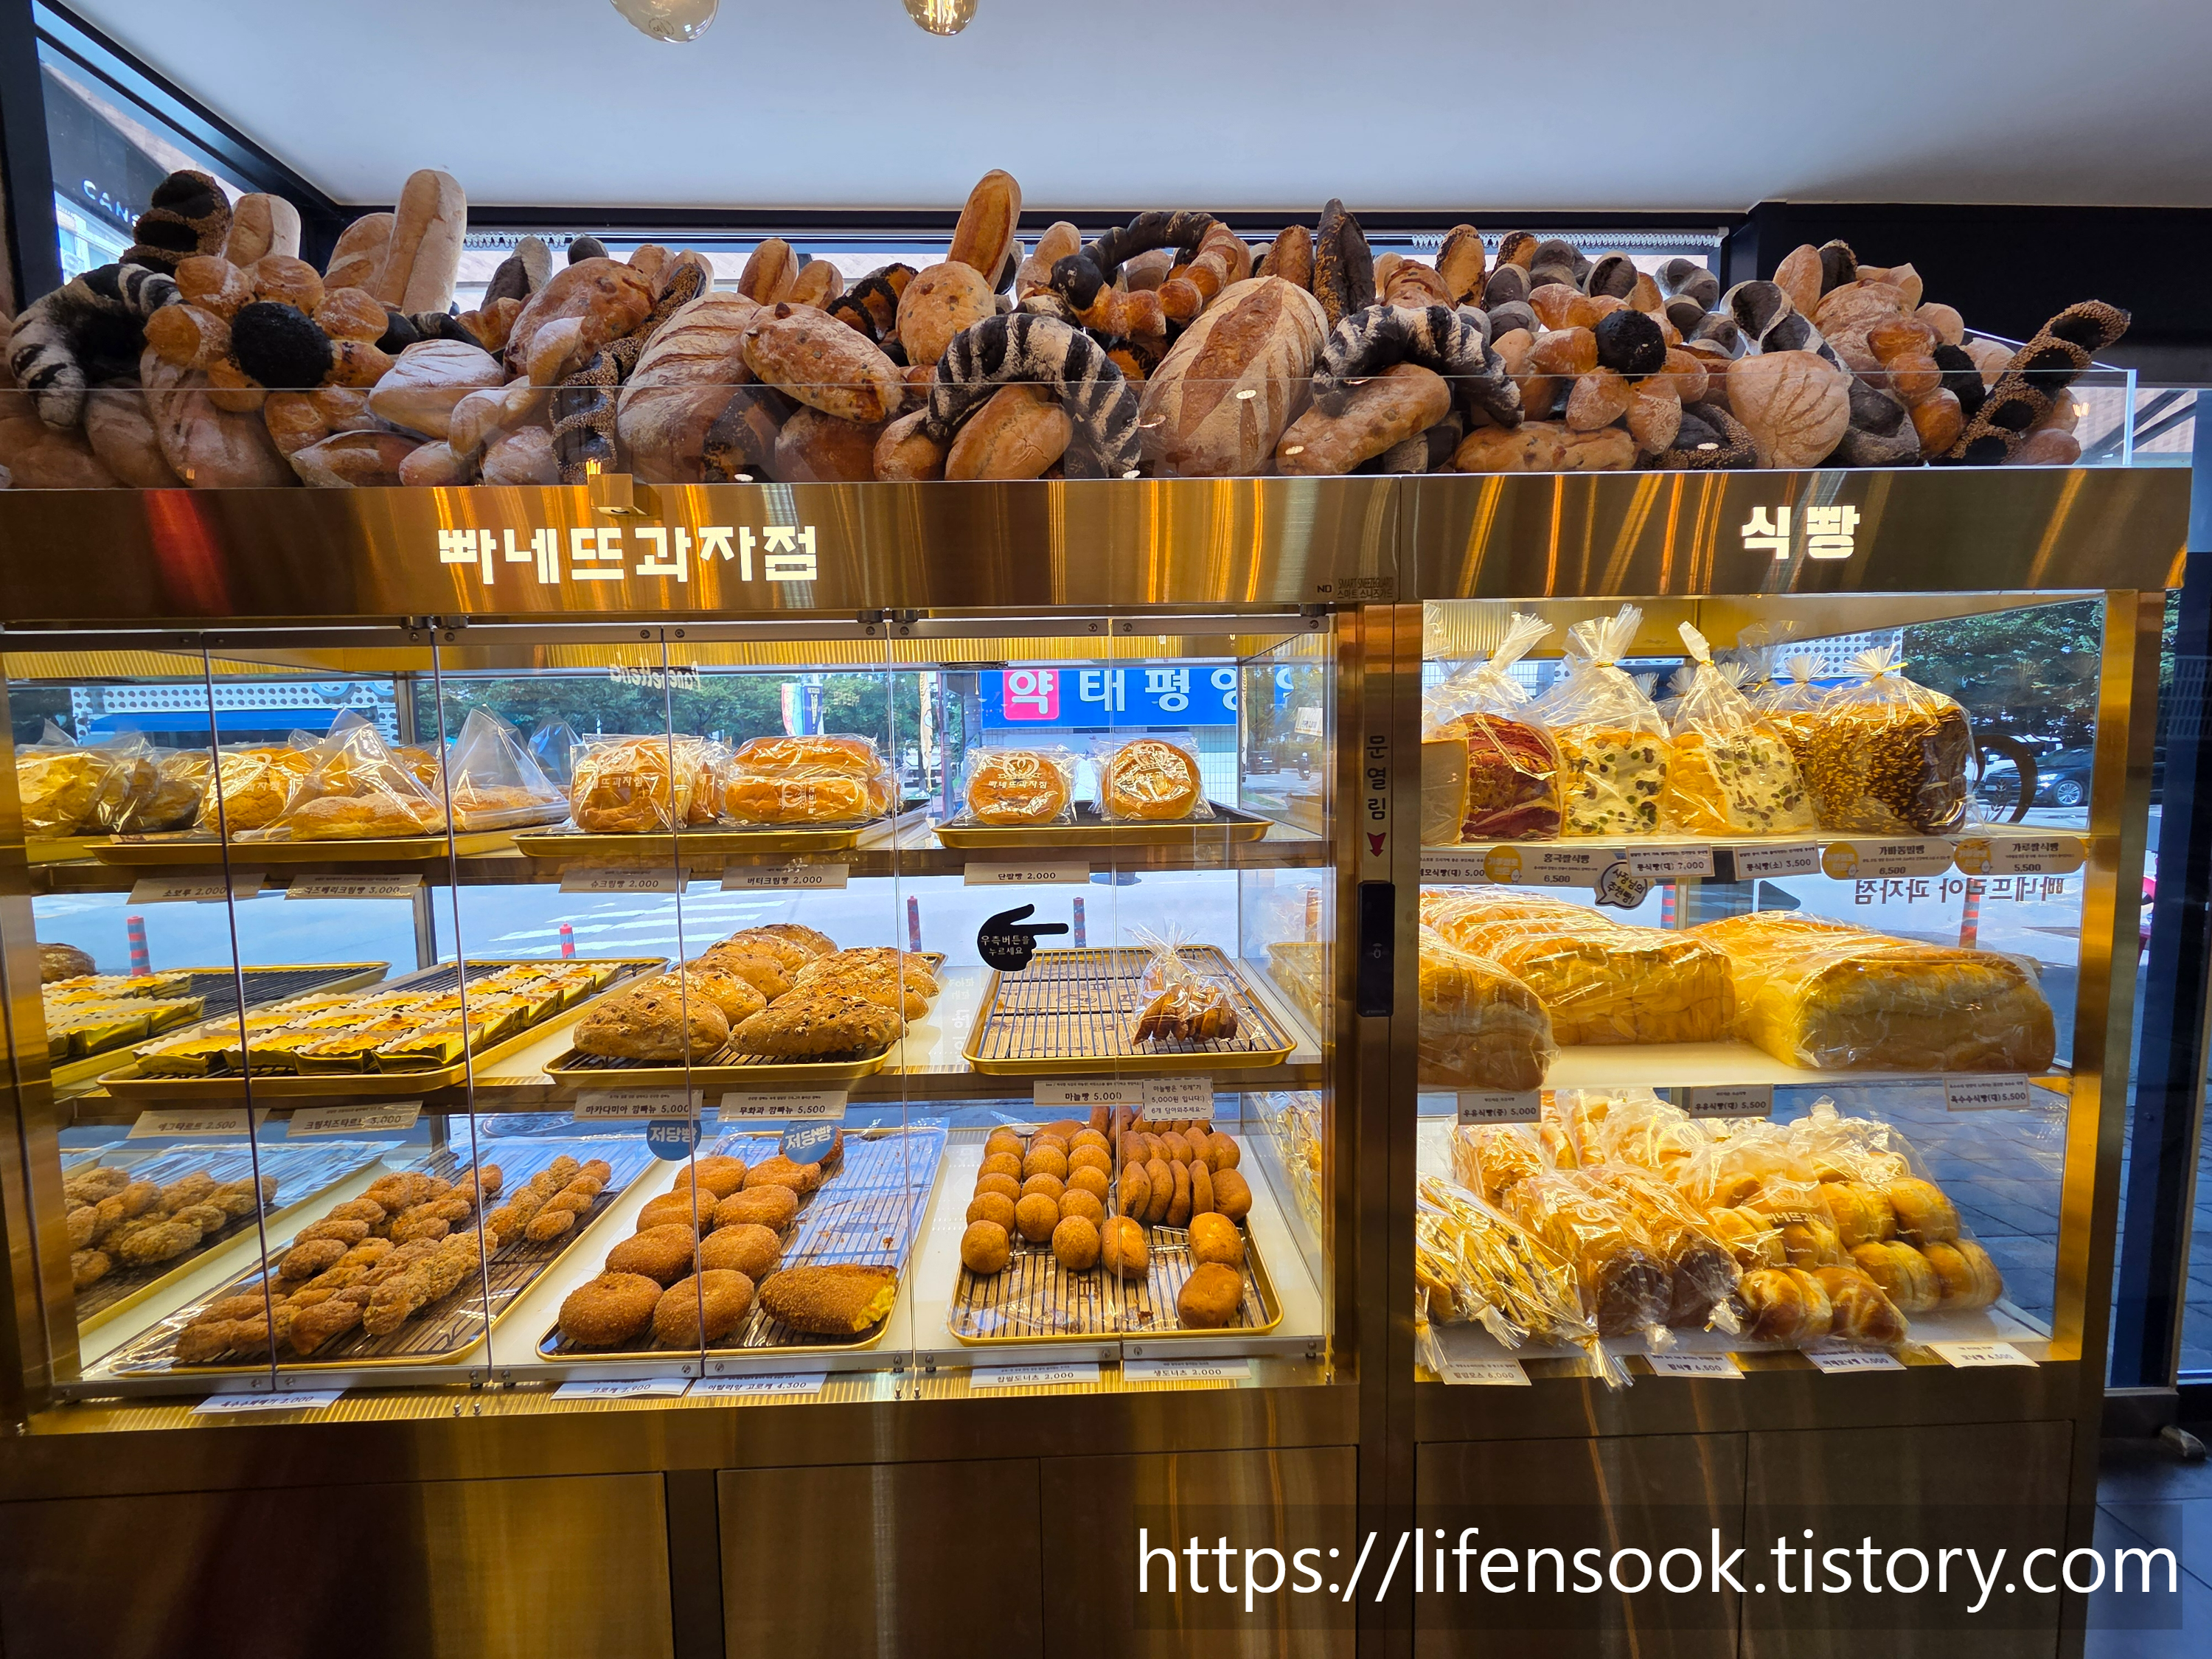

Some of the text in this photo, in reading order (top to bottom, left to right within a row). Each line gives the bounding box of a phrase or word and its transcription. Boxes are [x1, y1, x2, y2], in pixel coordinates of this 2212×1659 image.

[1742, 505, 1861, 560] 식빵
[438, 525, 817, 585] 빠네뜨과자점
[1337, 590, 1357, 599] 스마트
[1008, 669, 1054, 714] 약
[1366, 734, 1388, 821] 문열림
[2012, 842, 2059, 852] 가루쌀식빵
[1677, 861, 1704, 870] 7,000
[1786, 858, 1811, 868] 3,500
[2014, 863, 2041, 872] 5,500
[1464, 869, 1485, 877] 5,00
[1879, 866, 1906, 875] 6,500
[747, 877, 789, 886] 버터크림빵
[1544, 874, 1571, 883] 6,500
[1613, 868, 1644, 894] 사장님의
[591, 880, 658, 888] 슈크림빵 2,000
[195, 886, 227, 895] 2,000
[369, 886, 400, 894] 3,000
[981, 936, 1029, 946] 우측버튼을
[989, 947, 1023, 956] 누르세요
[1065, 1092, 1122, 1102] 마늘빵 5,000
[2003, 1092, 2026, 1102] 5,500
[585, 1104, 689, 1115] 마카다미아 깜빠뉴 5,000
[739, 1105, 826, 1116] 무화과 깜빠뉴 5,500
[1151, 1106, 1162, 1114] 6개
[1695, 1101, 1767, 1110] 우유식빵(대) 5,500
[1511, 1107, 1537, 1116] 5,000
[369, 1115, 402, 1124] 3,000
[205, 1120, 237, 1130] 2,500
[649, 1126, 698, 1143] 저당빵
[785, 1124, 834, 1150] 저당빵
[997, 1372, 1074, 1383] 찹쌀도너츠 2,000
